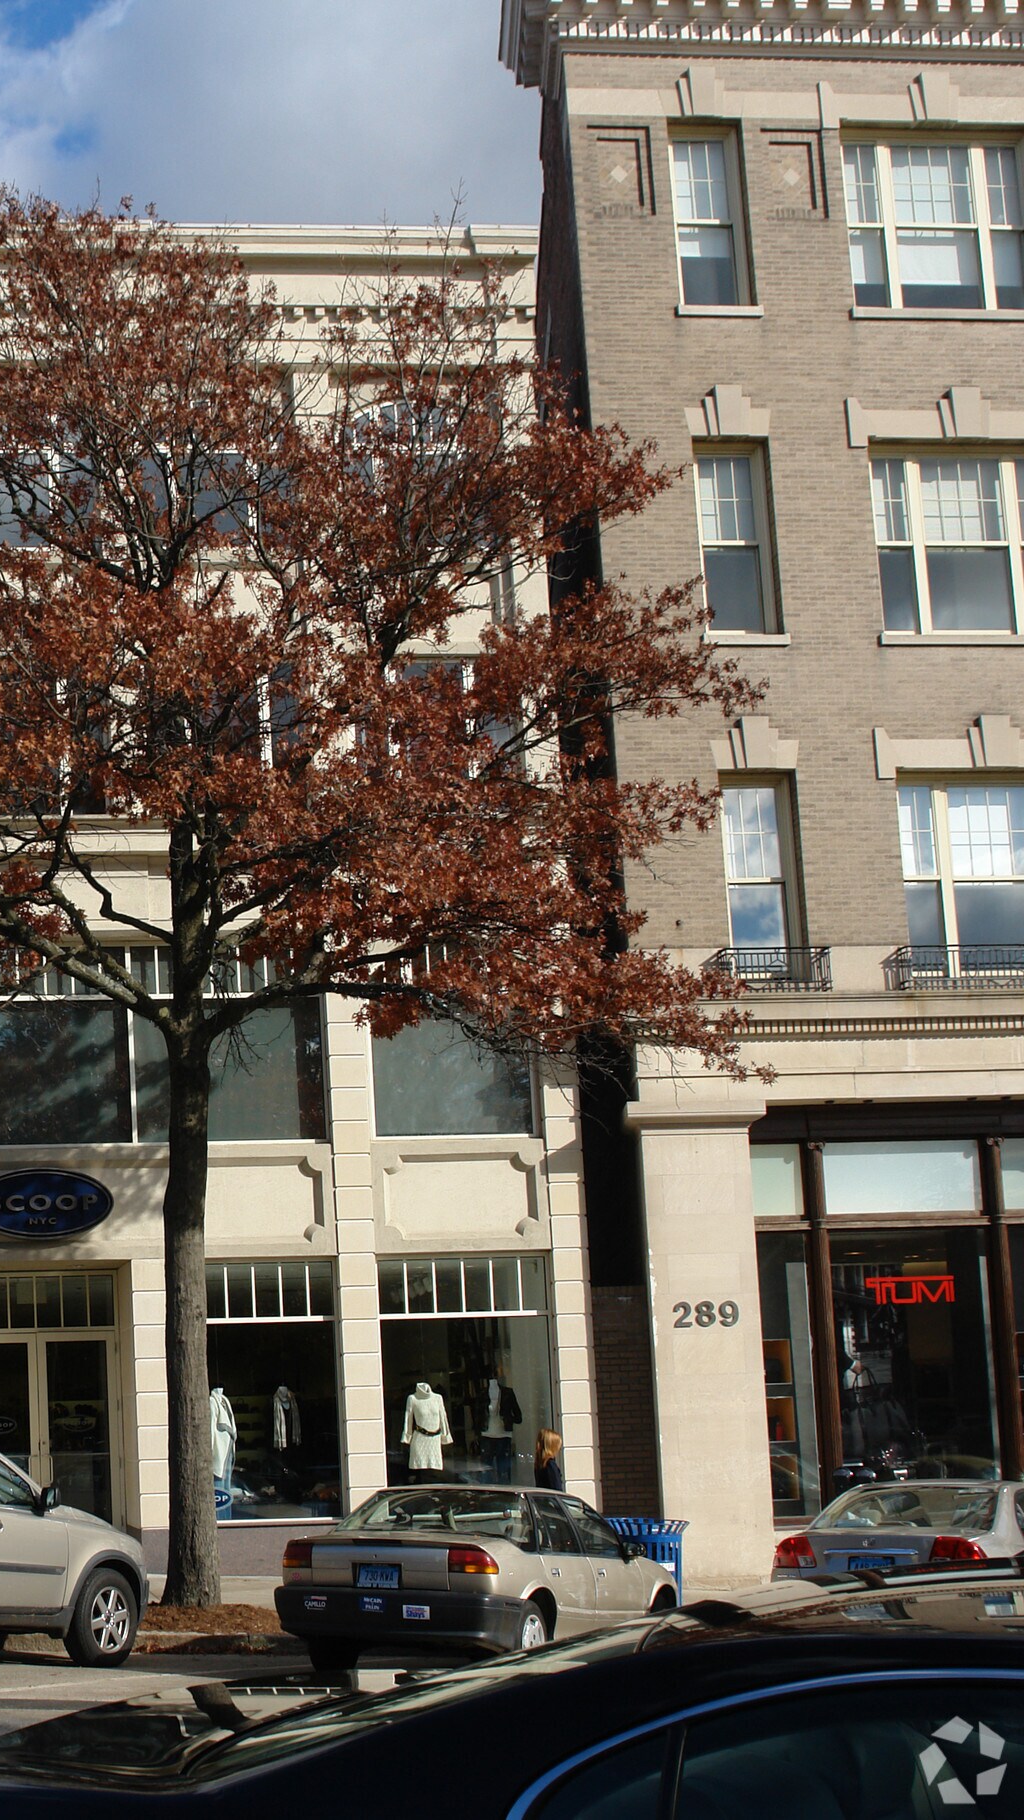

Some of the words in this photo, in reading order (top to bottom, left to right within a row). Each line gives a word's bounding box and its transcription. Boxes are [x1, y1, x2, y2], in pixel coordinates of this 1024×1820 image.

[29, 1217, 57, 1225] NYC
[866, 1275, 955, 1305] TUMI
[672, 1300, 740, 1328] 289
[304, 1600, 326, 1608] CAMILLO
